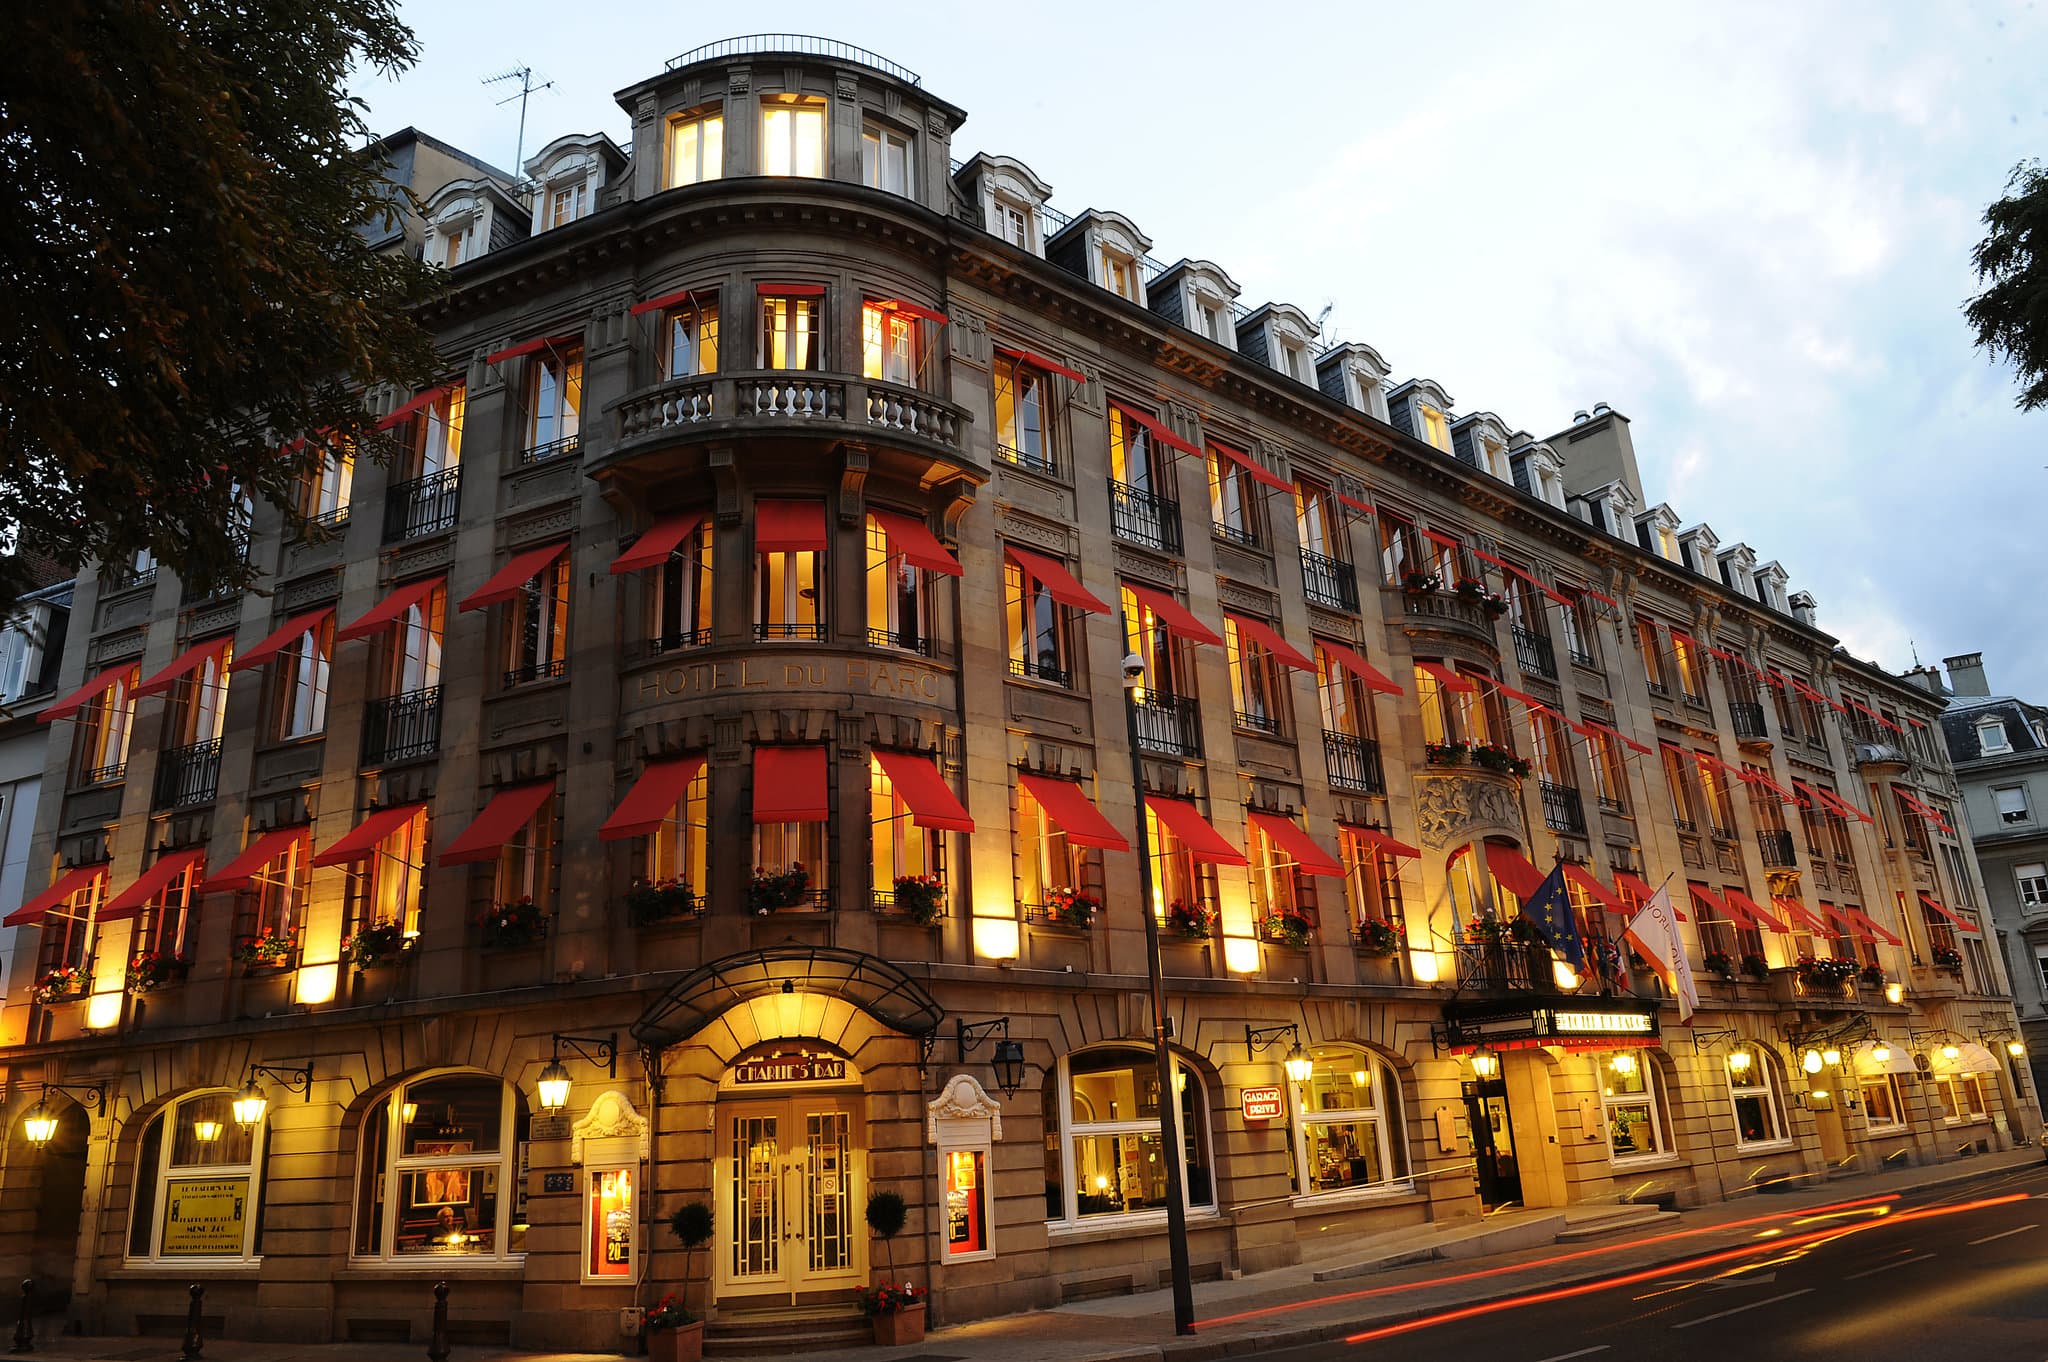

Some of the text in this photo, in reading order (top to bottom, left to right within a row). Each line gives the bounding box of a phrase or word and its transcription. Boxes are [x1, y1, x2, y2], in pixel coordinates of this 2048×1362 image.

[638, 658, 939, 702] HOTEL DU PARC
[736, 1062, 843, 1082] CHARLIE'S BAR
[1244, 1091, 1279, 1103] GARAGE
[608, 1242, 621, 1261] 20
